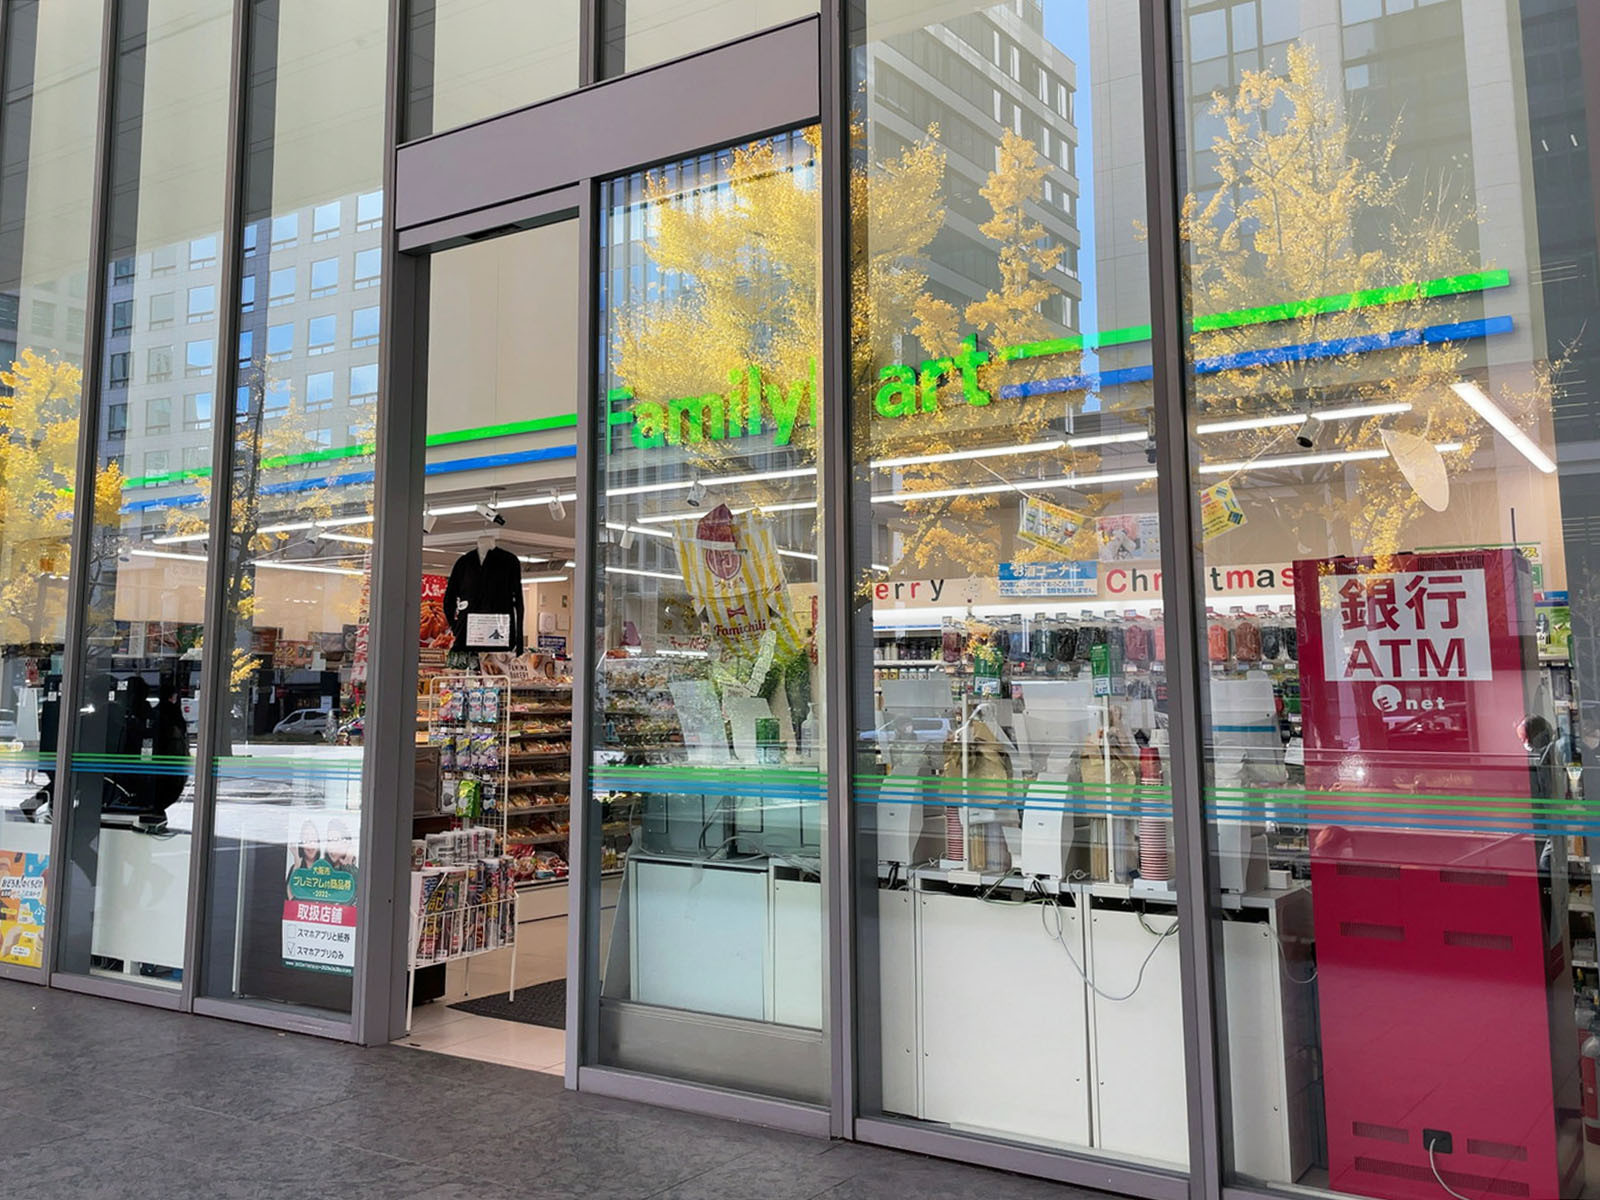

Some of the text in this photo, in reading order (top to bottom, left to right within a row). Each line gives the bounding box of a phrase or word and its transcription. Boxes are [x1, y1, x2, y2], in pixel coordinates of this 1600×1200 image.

[607, 333, 992, 454] Familyart
[875, 567, 1294, 601] erry Chrtmas
[1338, 575, 1466, 632] 銀行
[1343, 638, 1468, 678] ATM
[1405, 697, 1445, 711] net
[297, 903, 343, 924] 取扱店舗
[297, 928, 351, 943] スマホアプリと紙券
[296, 945, 345, 960] スマホアプリのみ
